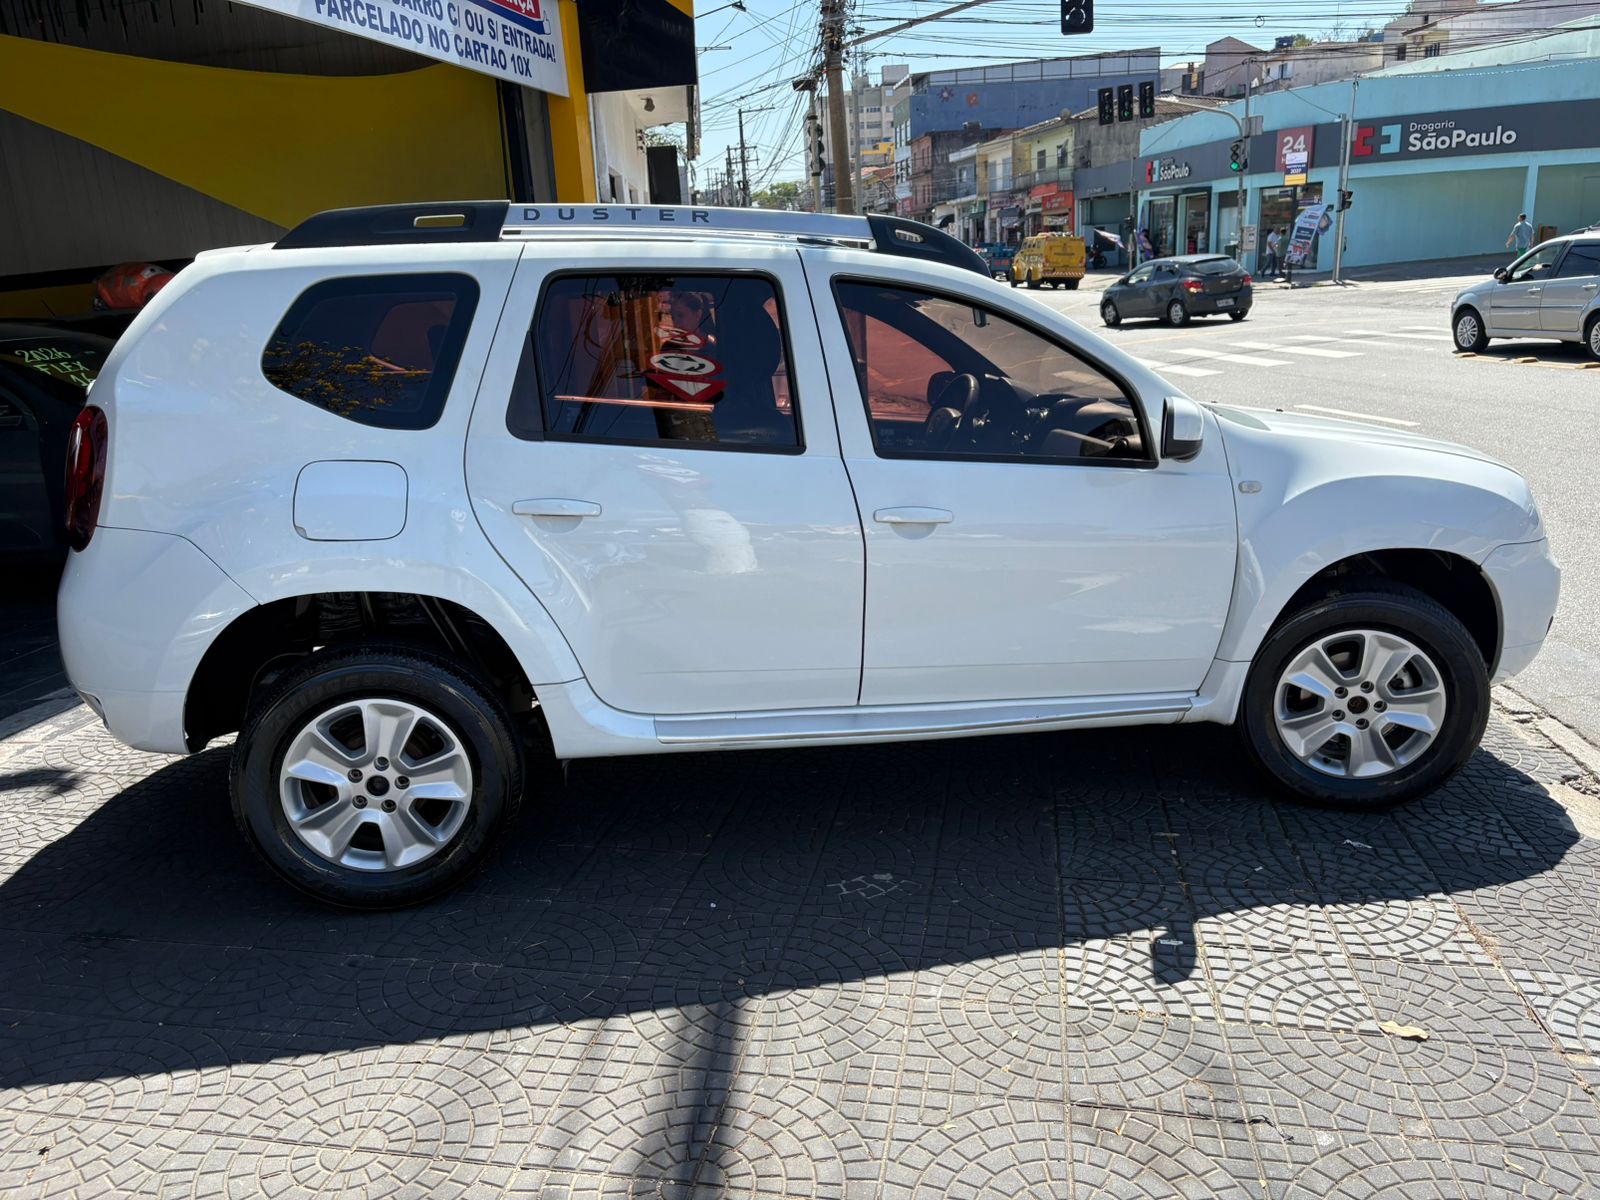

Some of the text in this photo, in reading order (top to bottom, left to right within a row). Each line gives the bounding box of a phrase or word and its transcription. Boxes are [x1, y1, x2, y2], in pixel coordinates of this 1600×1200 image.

[314, 0, 532, 78] PARCELADO NO CARTAO 10X
[392, 0, 556, 63] RRO C/ OU S/ ENTRADA!
[1409, 120, 1456, 132] Drogaria
[1282, 134, 1305, 154] 24
[523, 208, 710, 223] DUSTER
[33, 361, 90, 376] FLEX
